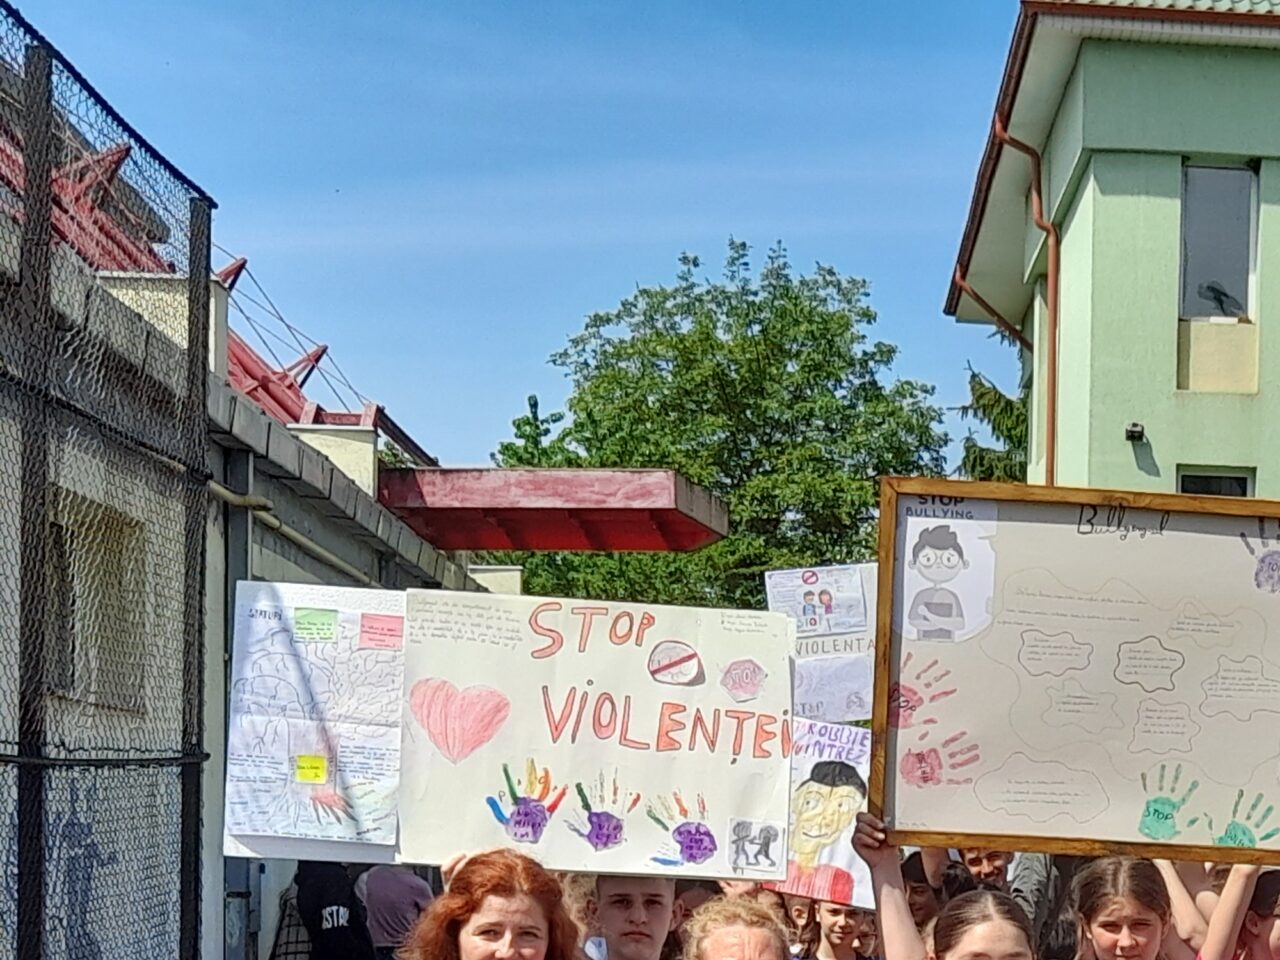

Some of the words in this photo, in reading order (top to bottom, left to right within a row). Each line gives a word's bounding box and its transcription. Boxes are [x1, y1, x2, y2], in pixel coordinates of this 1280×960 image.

[906, 506, 974, 520] BULLYING
[529, 602, 656, 659] STOP
[1143, 806, 1174, 821] STOP
